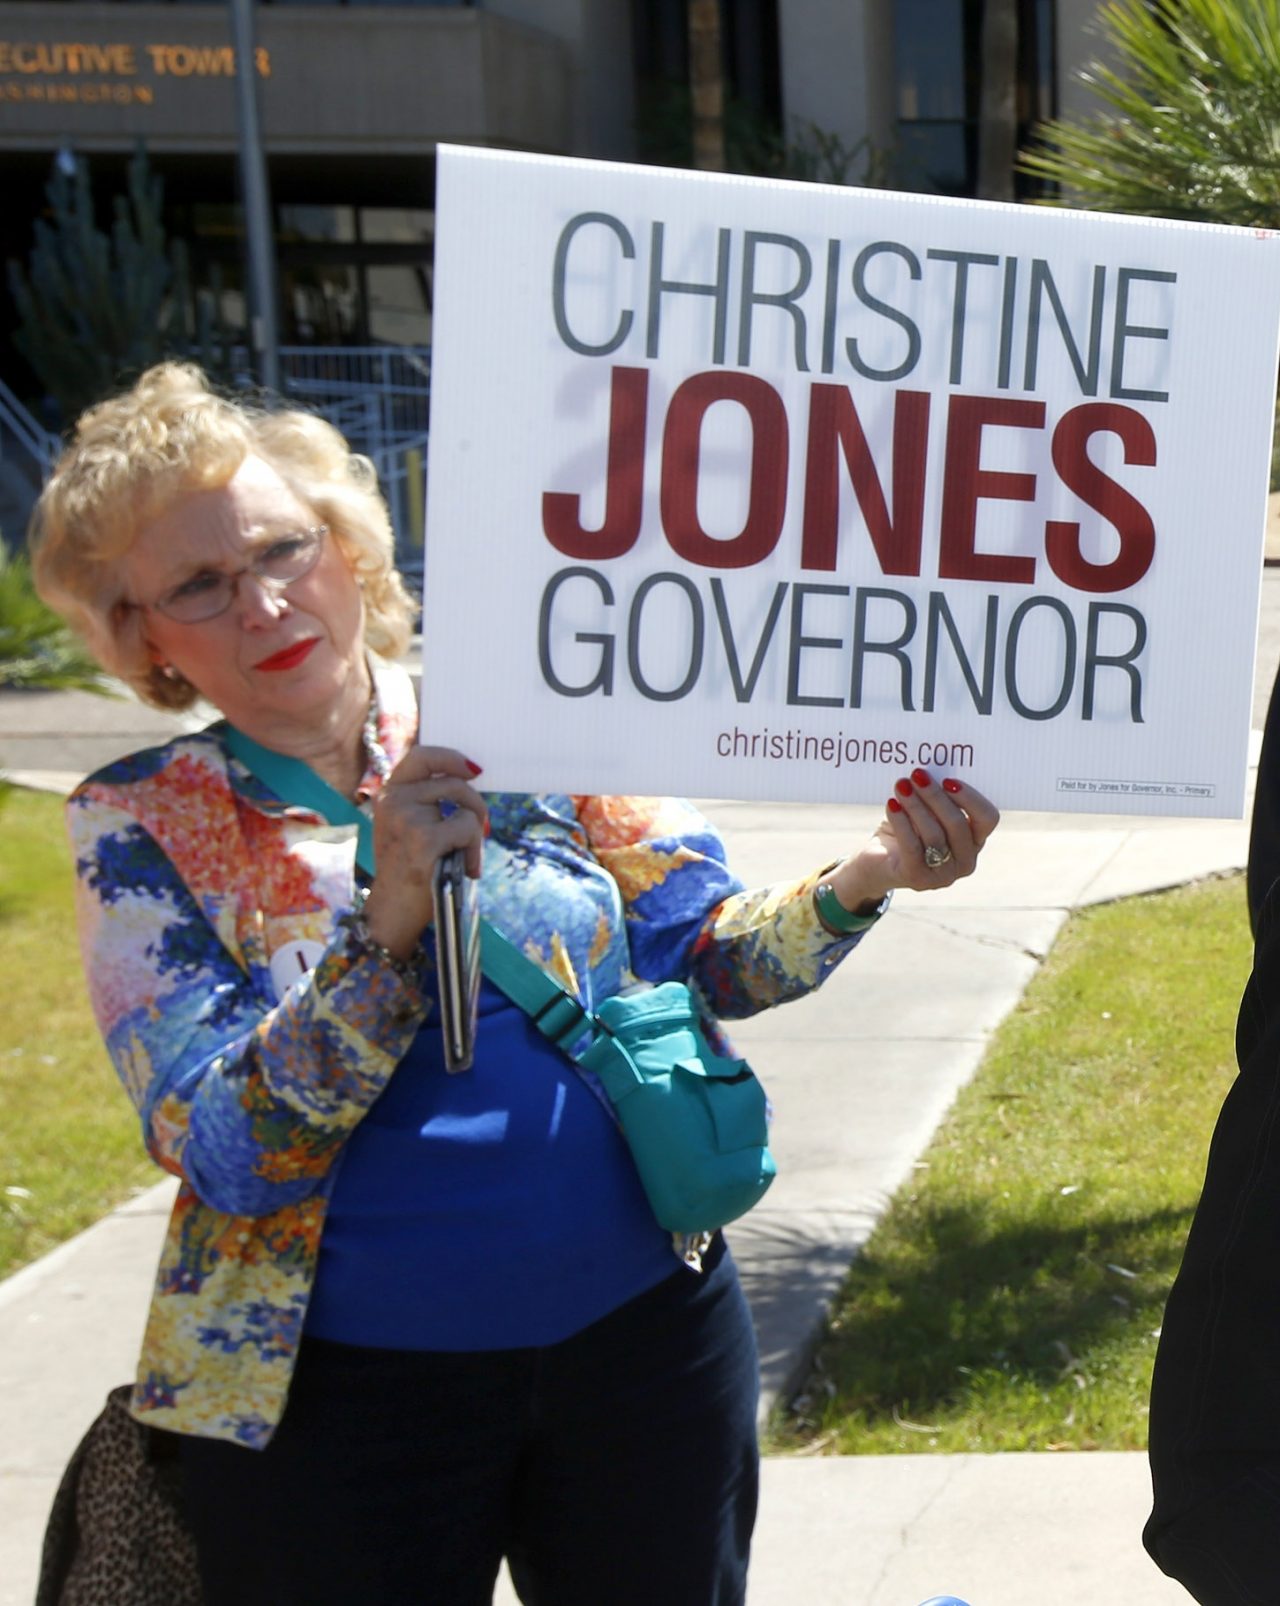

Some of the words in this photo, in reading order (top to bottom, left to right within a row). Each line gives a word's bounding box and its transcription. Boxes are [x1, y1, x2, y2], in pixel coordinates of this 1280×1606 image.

[550, 211, 1177, 403] CHRISTINE
[541, 364, 1158, 595] JONES
[537, 565, 1147, 724] GOVERNOR
[717, 726, 975, 768] christinejones.com
[1061, 781, 1076, 790] Paid
[1077, 781, 1087, 790] for
[1088, 782, 1097, 792] by
[1098, 783, 1119, 792] Jones
[1120, 783, 1130, 792] for
[1184, 786, 1211, 796] Primary
